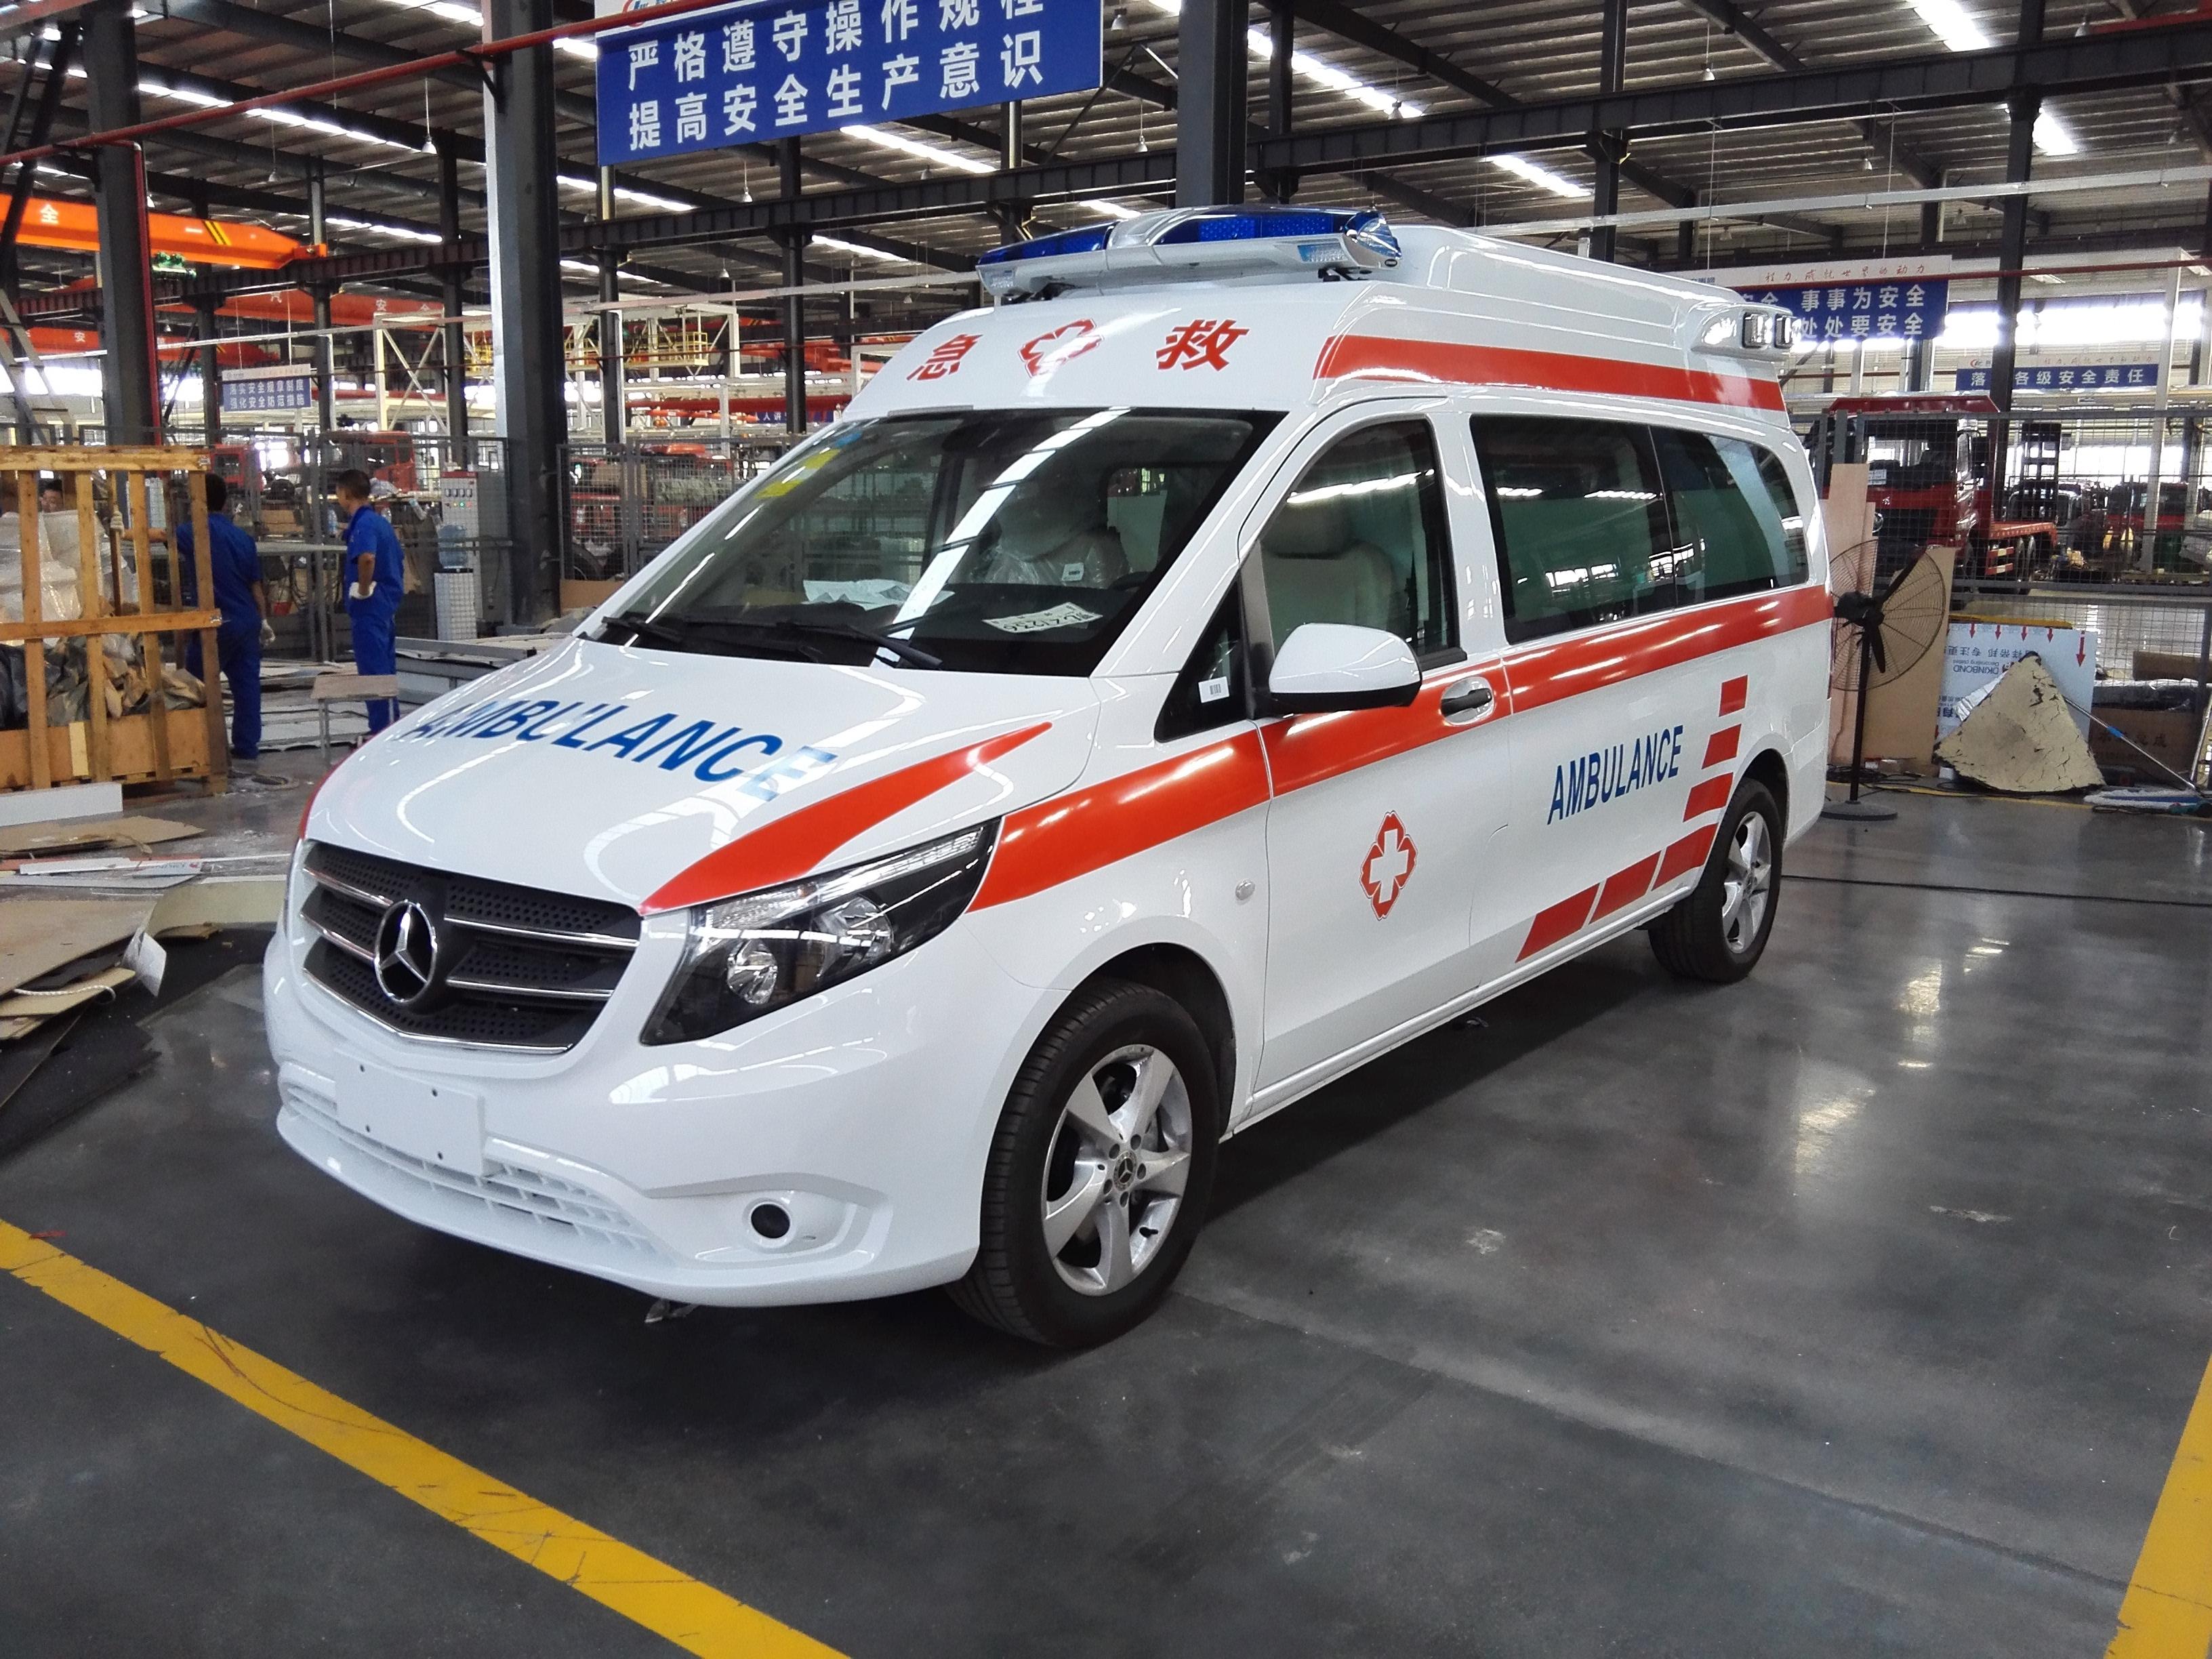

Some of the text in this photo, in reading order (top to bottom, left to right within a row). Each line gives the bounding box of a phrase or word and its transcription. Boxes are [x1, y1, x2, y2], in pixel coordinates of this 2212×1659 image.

[630, 30, 1043, 150] 提高安全生产意识
[40, 204, 59, 225] 全
[1801, 284, 1925, 312] 事事为安全
[907, 319, 1250, 382] 急 救
[398, 699, 837, 802] AMBULANCE
[1547, 724, 1683, 825] AMBULANCE
